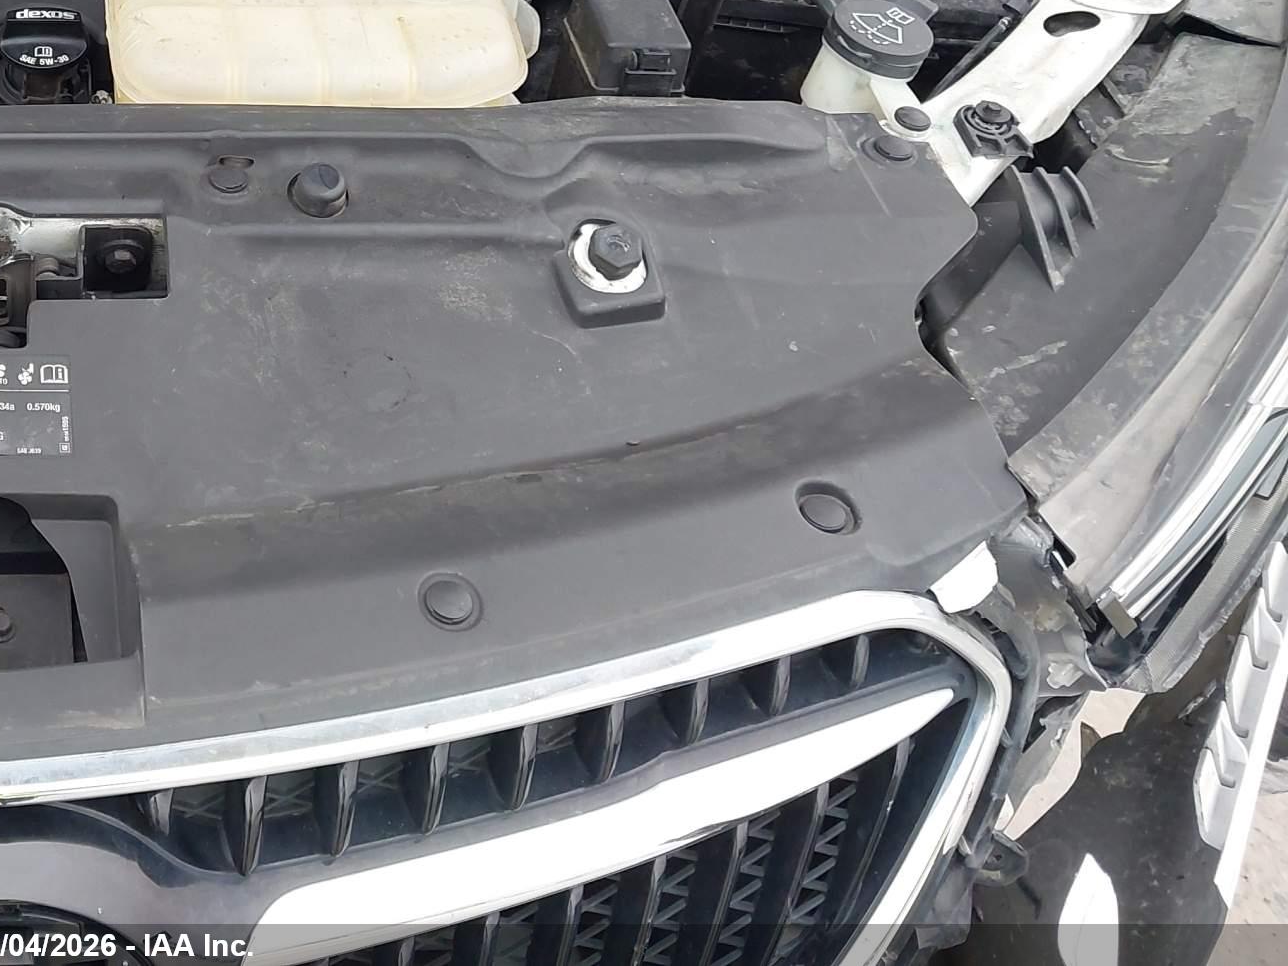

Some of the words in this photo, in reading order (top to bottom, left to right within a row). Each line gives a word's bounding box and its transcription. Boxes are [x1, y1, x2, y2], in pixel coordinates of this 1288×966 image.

[15, 9, 78, 20] dexos
[19, 54, 37, 65] SAE
[39, 54, 70, 66] 5W-30
[26, 402, 61, 413] 0.570kg
